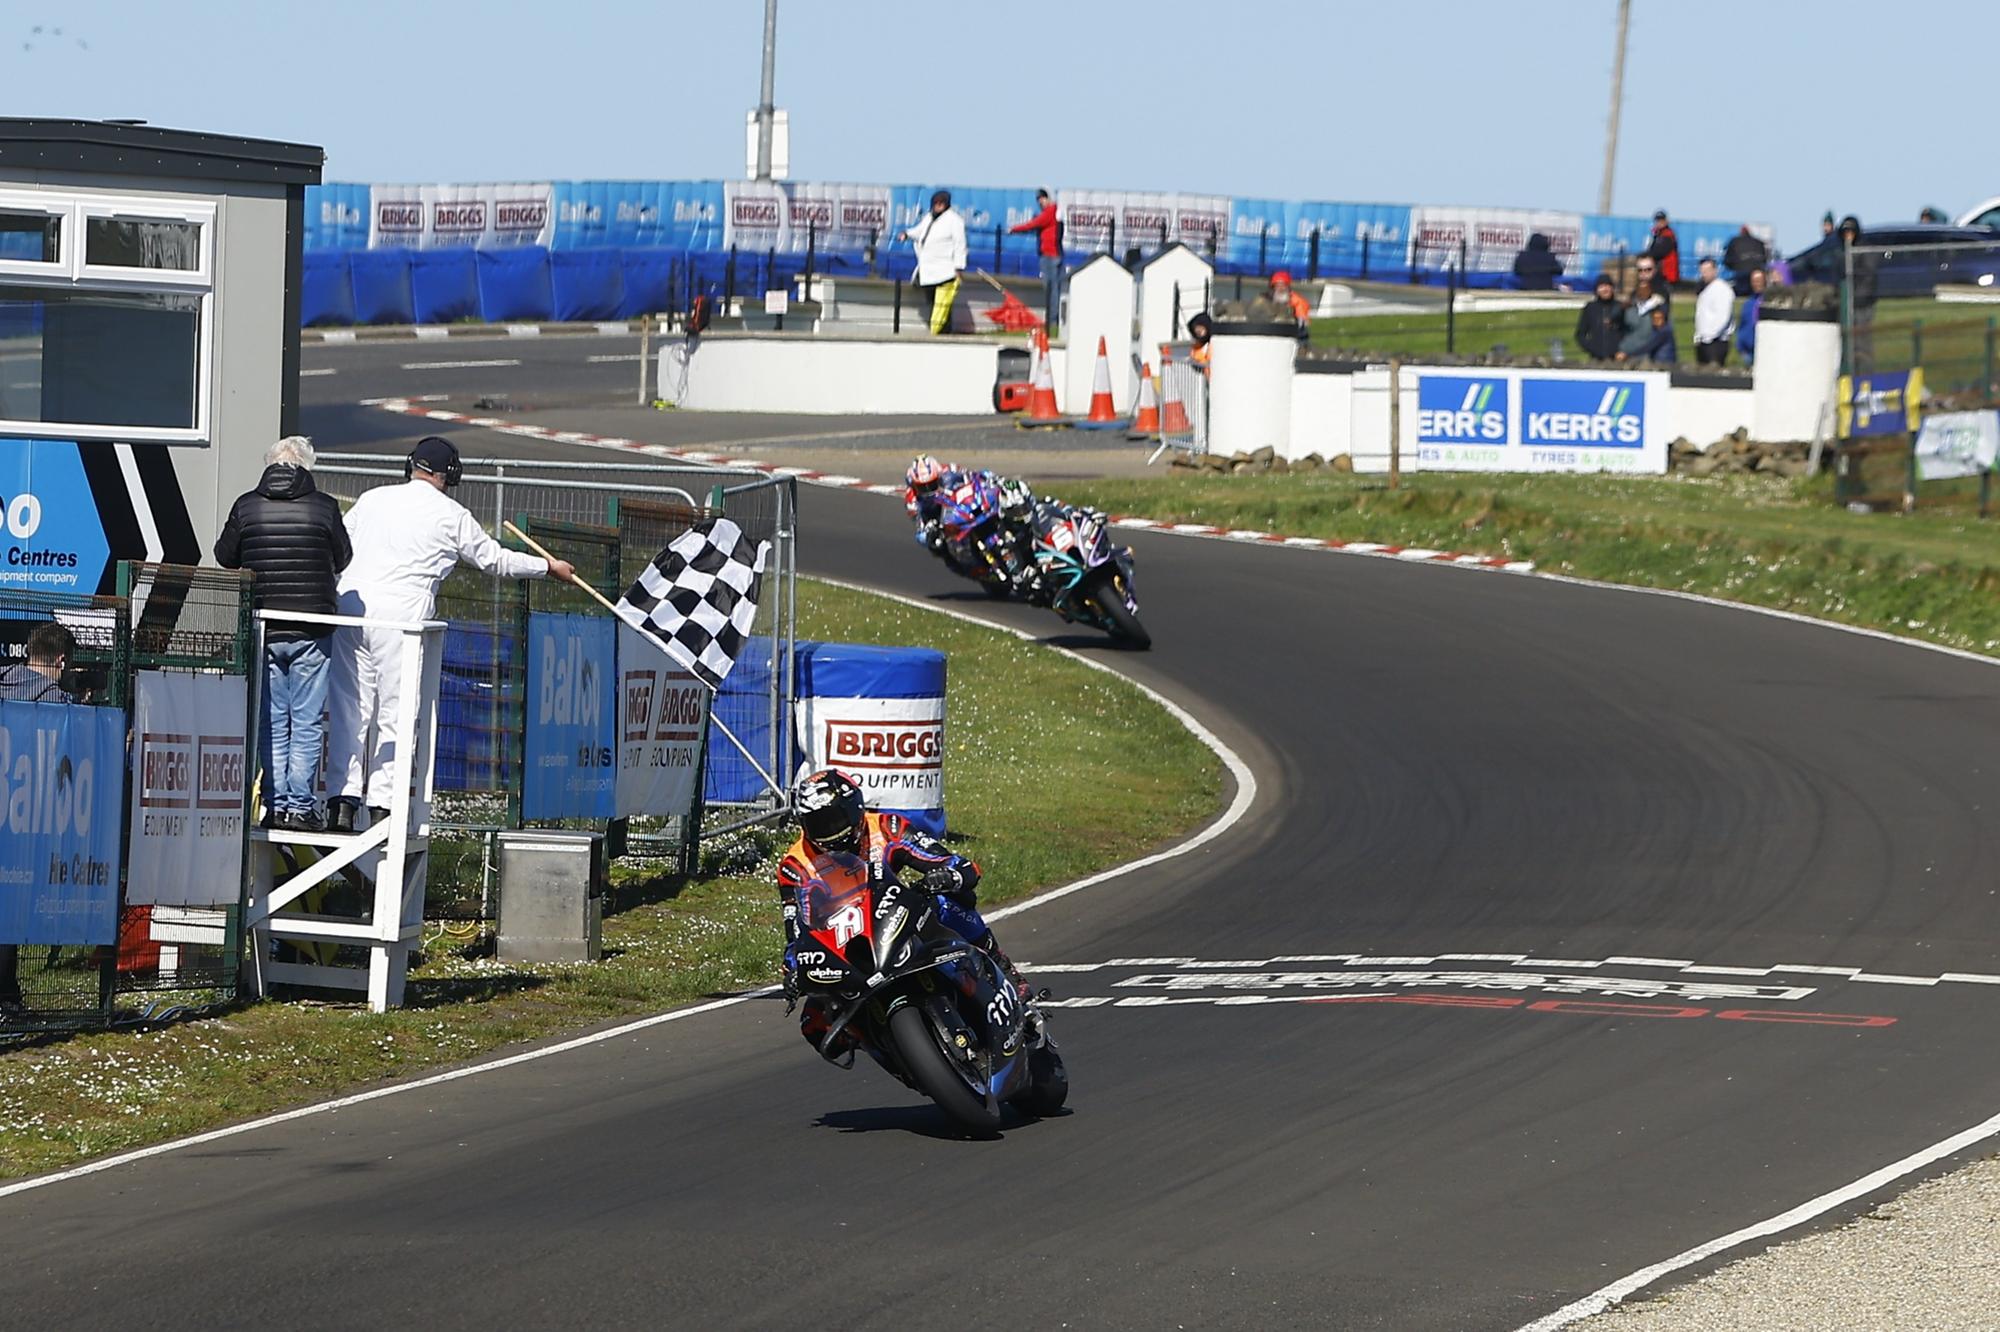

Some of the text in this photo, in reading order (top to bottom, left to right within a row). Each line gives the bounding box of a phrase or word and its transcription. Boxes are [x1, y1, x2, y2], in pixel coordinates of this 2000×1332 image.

[382, 209, 419, 225] BRIGGS
[437, 209, 482, 225] BRIGGS
[499, 207, 544, 222] BRIGGS
[736, 206, 776, 221] BRIGGS
[790, 207, 829, 222] BRIGGS
[843, 208, 883, 224] BRIGGS
[1419, 409, 1505, 440] ERR'S
[1528, 412, 1642, 443] KERR'S
[8, 546, 78, 567] Centres
[35, 571, 78, 585] company
[540, 635, 600, 727] Balloo
[837, 731, 941, 758] BRIGGS
[850, 773, 940, 789] QUIPMENT
[809, 967, 843, 979] alpha
